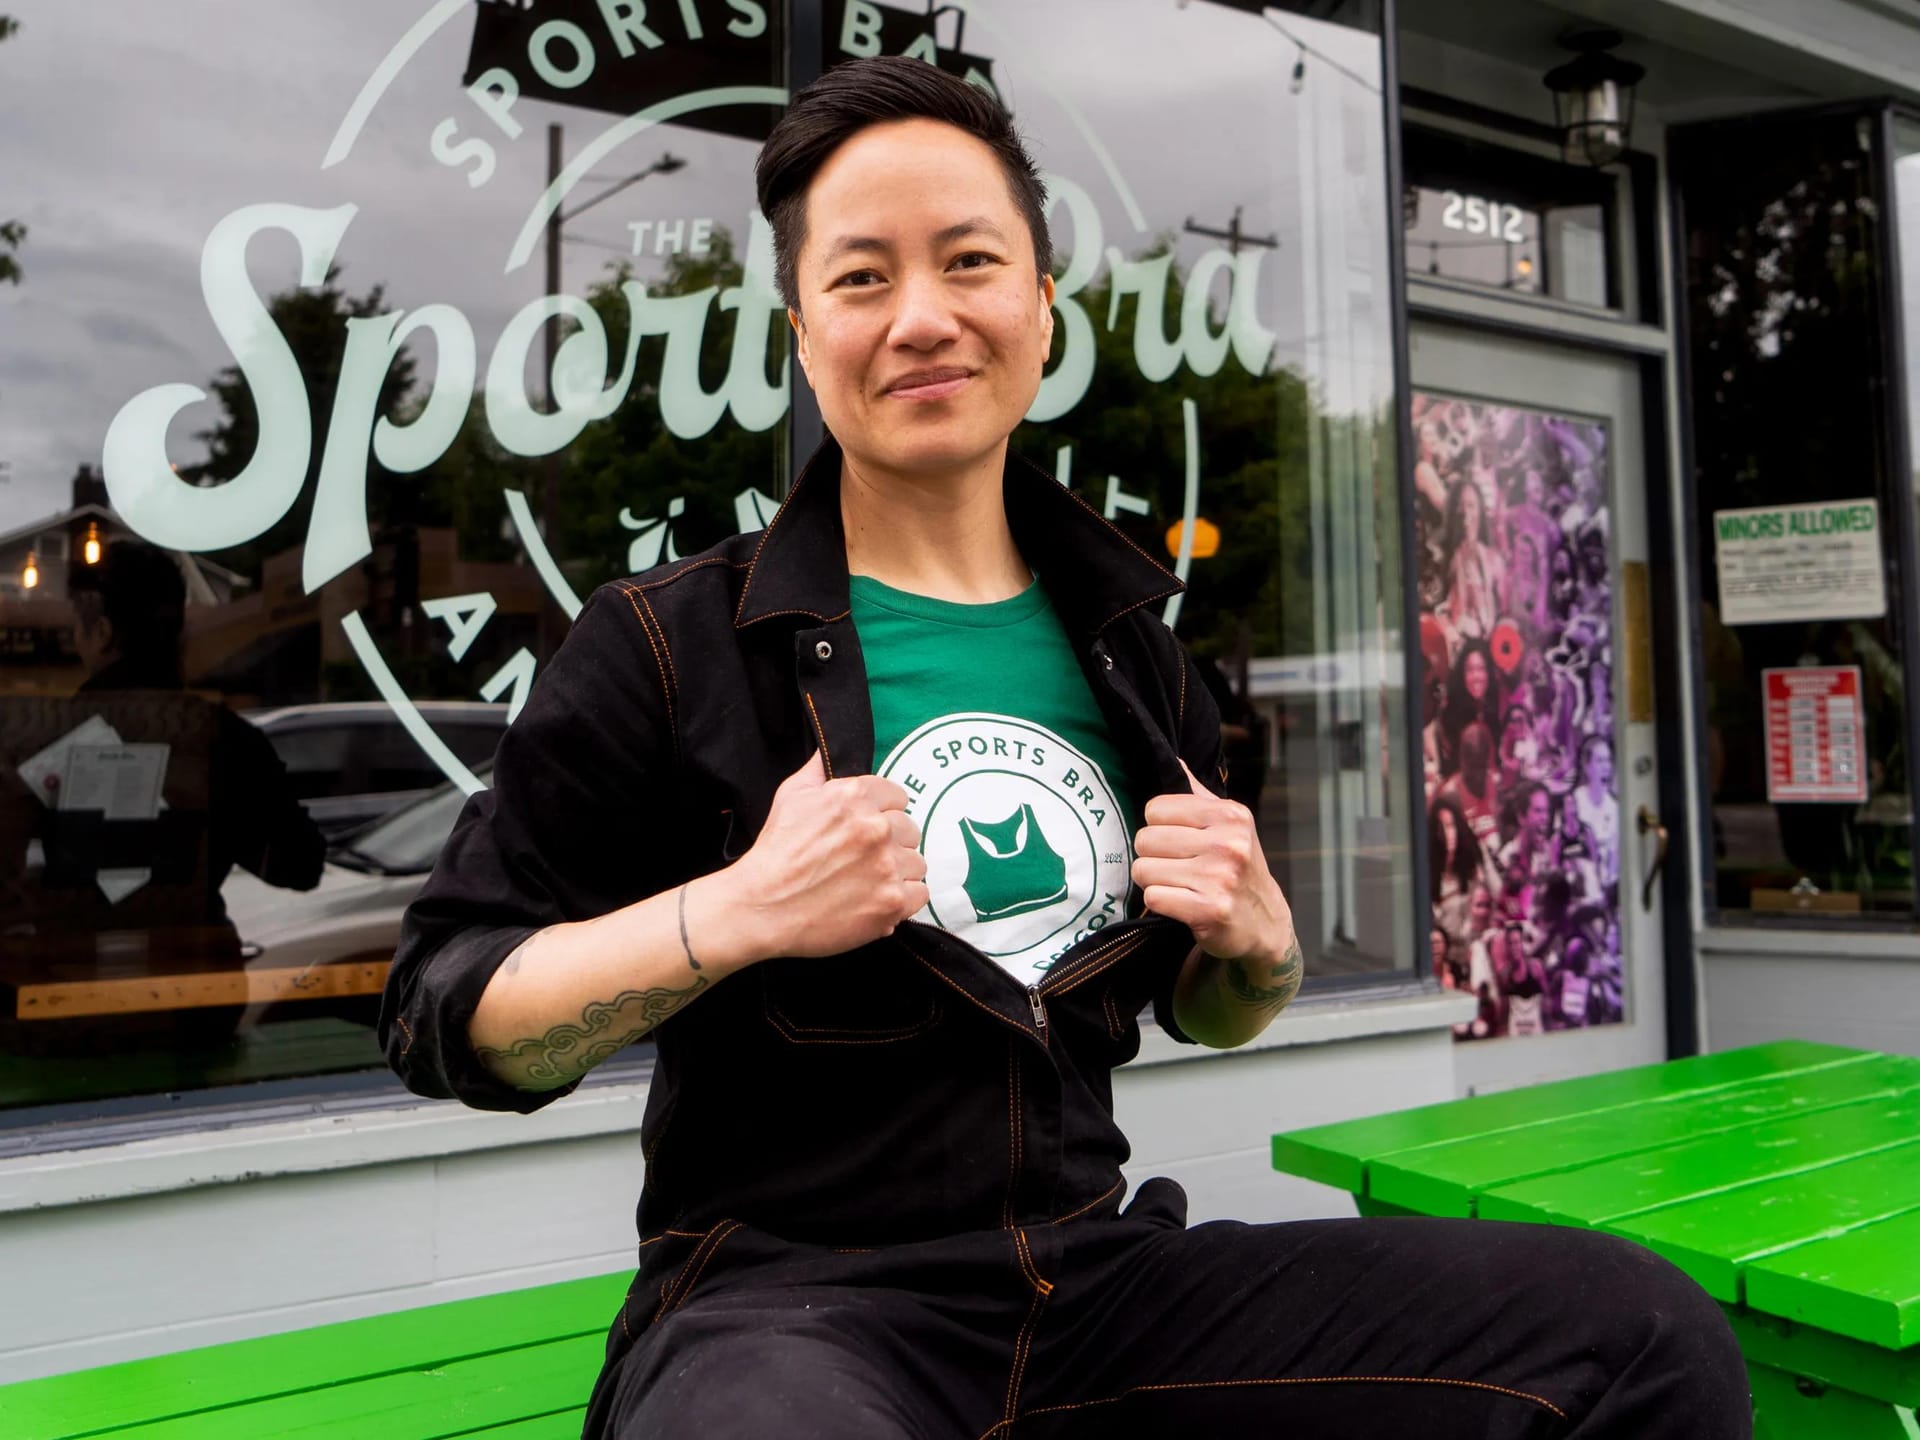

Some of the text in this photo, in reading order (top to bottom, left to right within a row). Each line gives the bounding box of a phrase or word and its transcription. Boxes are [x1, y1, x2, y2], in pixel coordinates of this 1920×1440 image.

[627, 218, 713, 257] THE
[1442, 190, 1524, 242] 2512
[102, 203, 790, 595] Sport
[1718, 504, 1875, 541] MINORS ALLOWED
[932, 735, 1107, 827] SPORTS BRA
